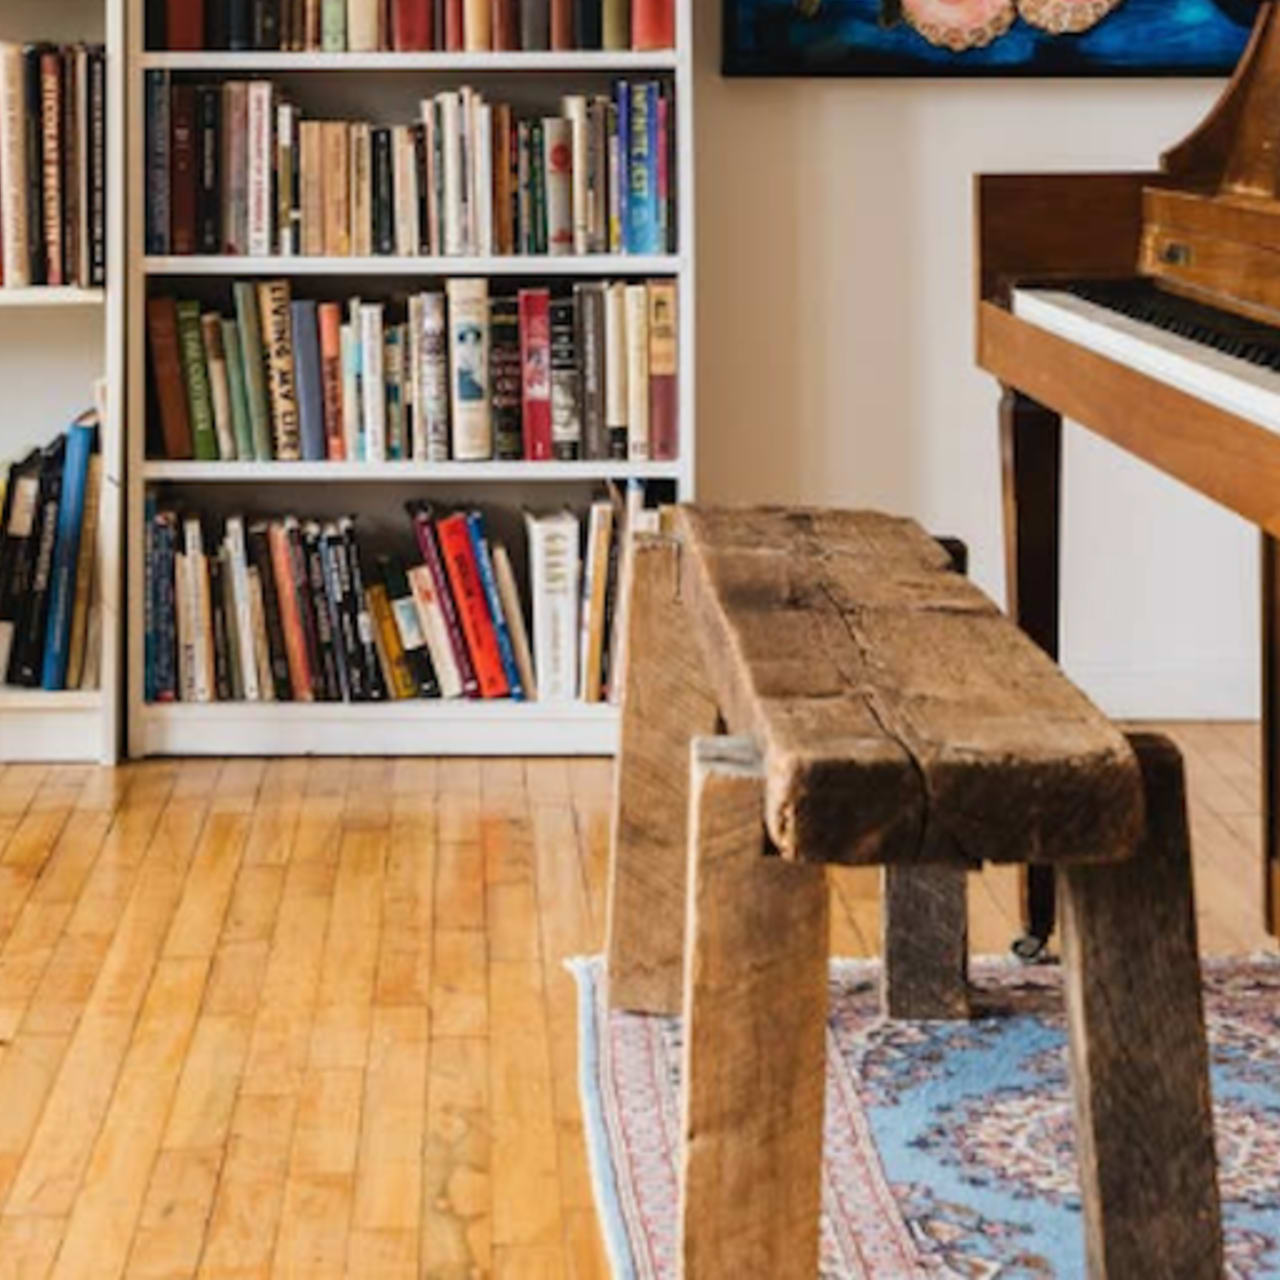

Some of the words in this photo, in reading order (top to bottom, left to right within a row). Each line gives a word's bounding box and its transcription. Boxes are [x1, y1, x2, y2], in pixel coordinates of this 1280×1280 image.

[271, 286, 292, 359] LIVING
[279, 371, 295, 402] MY
[282, 409, 299, 451] LIFE
